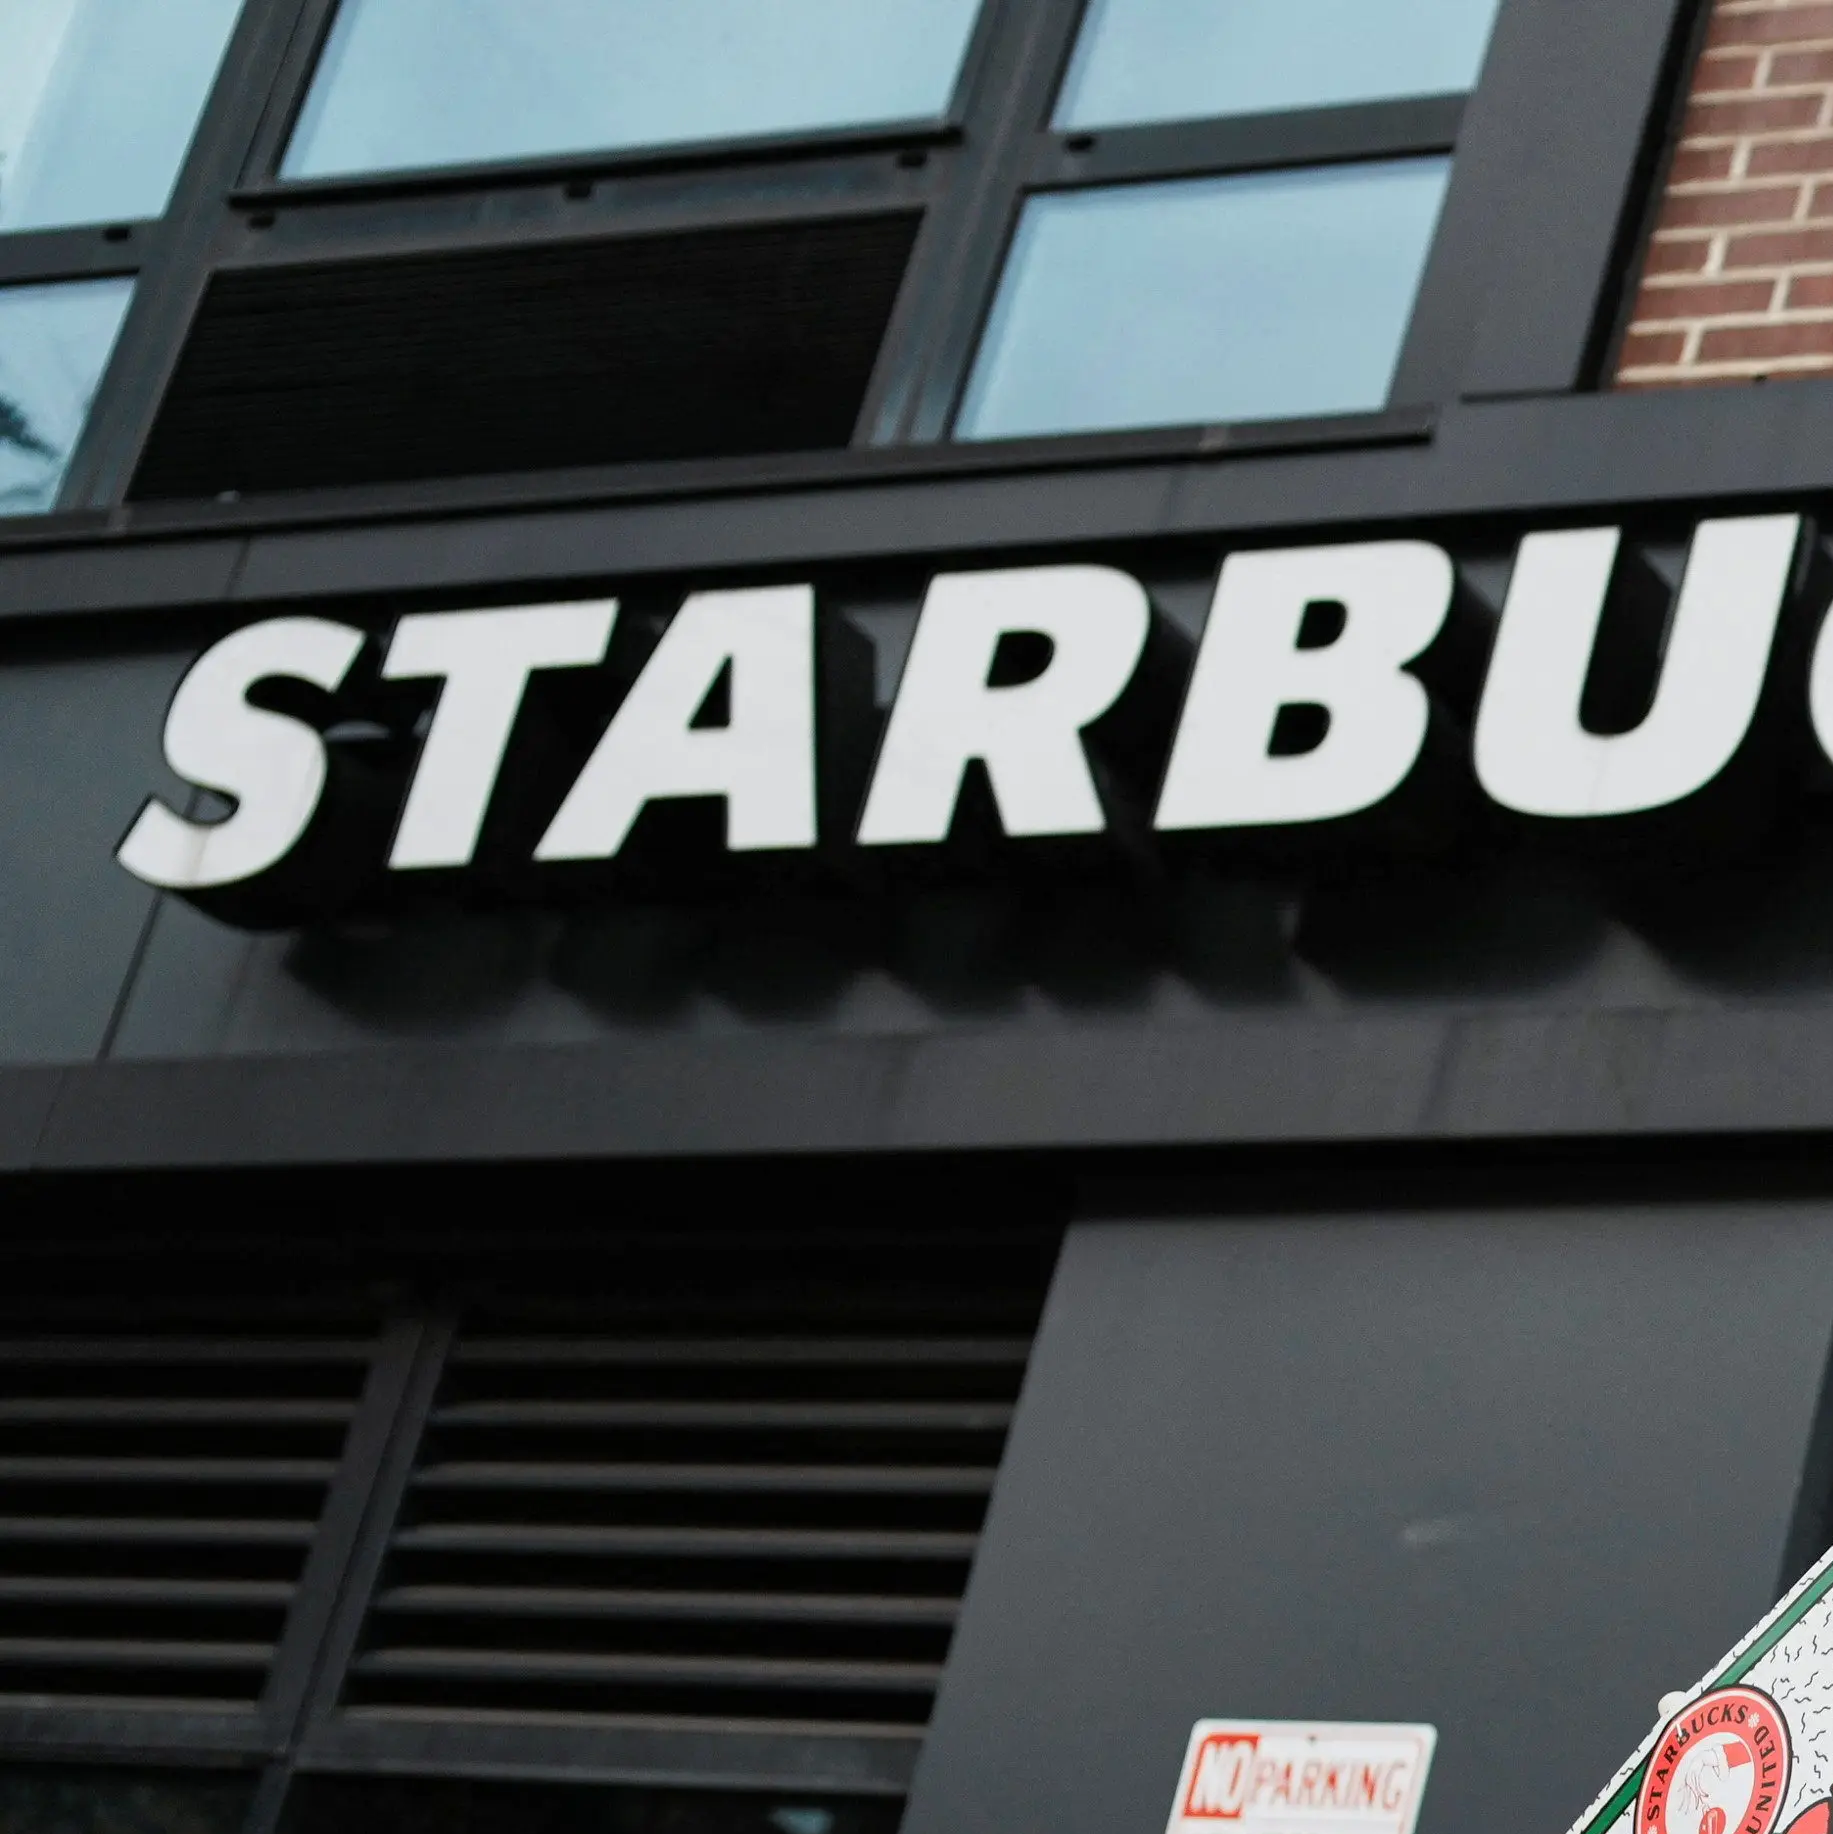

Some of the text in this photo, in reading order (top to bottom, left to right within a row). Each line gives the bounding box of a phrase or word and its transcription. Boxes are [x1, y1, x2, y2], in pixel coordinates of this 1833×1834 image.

[1192, 1738, 1406, 1815] NO PARKING
[1646, 1703, 1749, 1822] STARBUCKS
